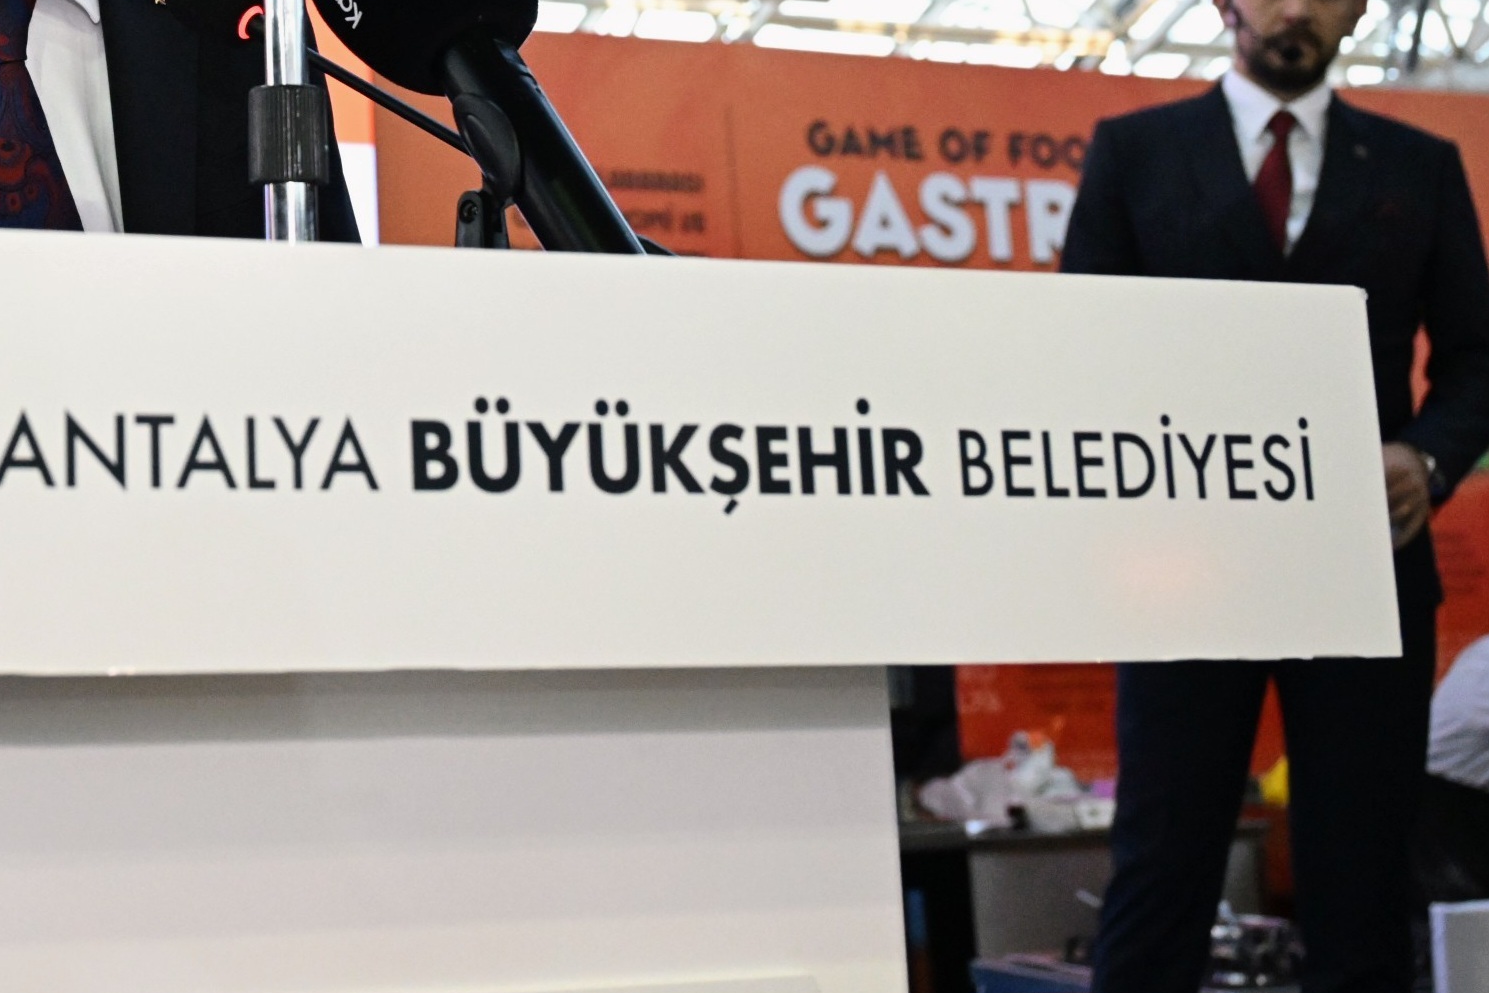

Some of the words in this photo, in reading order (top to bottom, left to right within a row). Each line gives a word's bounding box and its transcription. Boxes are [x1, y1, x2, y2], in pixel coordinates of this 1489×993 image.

[806, 119, 923, 161] GAME
[938, 127, 990, 163] OF
[1008, 131, 1091, 170] FOO
[777, 165, 1079, 264] GASTR
[411, 396, 931, 515] BÜYÜKŞEHİR
[957, 413, 1315, 501] BELEDİYESİ
